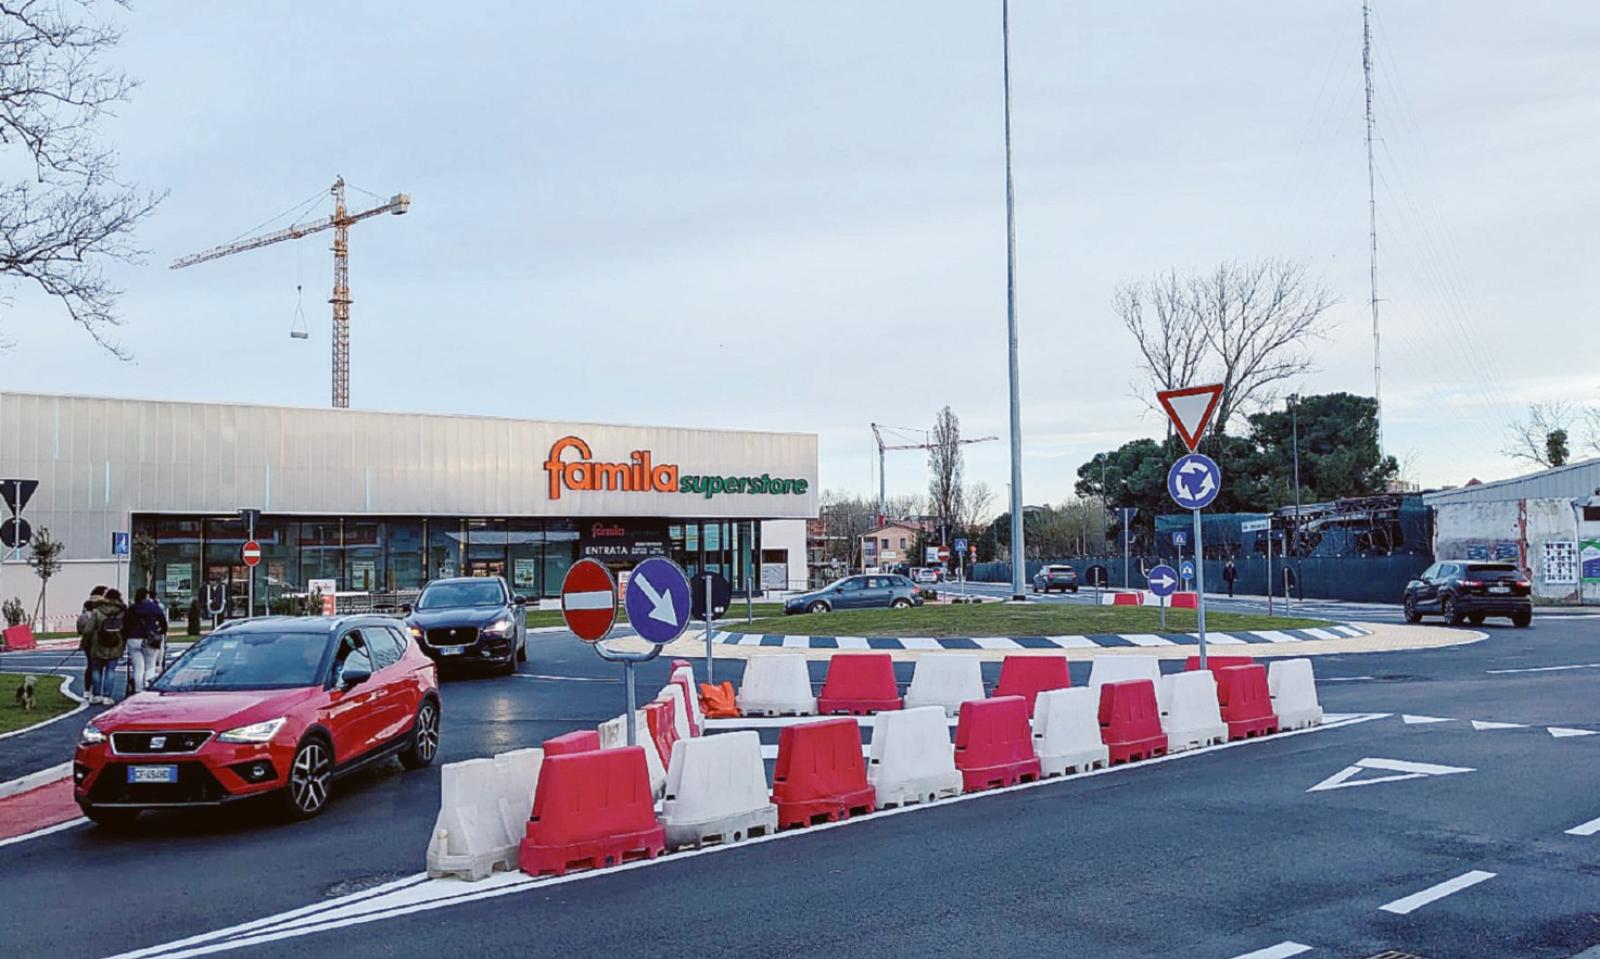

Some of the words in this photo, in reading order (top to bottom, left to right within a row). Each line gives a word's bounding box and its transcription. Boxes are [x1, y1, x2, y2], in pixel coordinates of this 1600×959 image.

[544, 436, 679, 499] famila
[679, 474, 808, 499] superstore
[585, 546, 628, 555] ENTRATA
